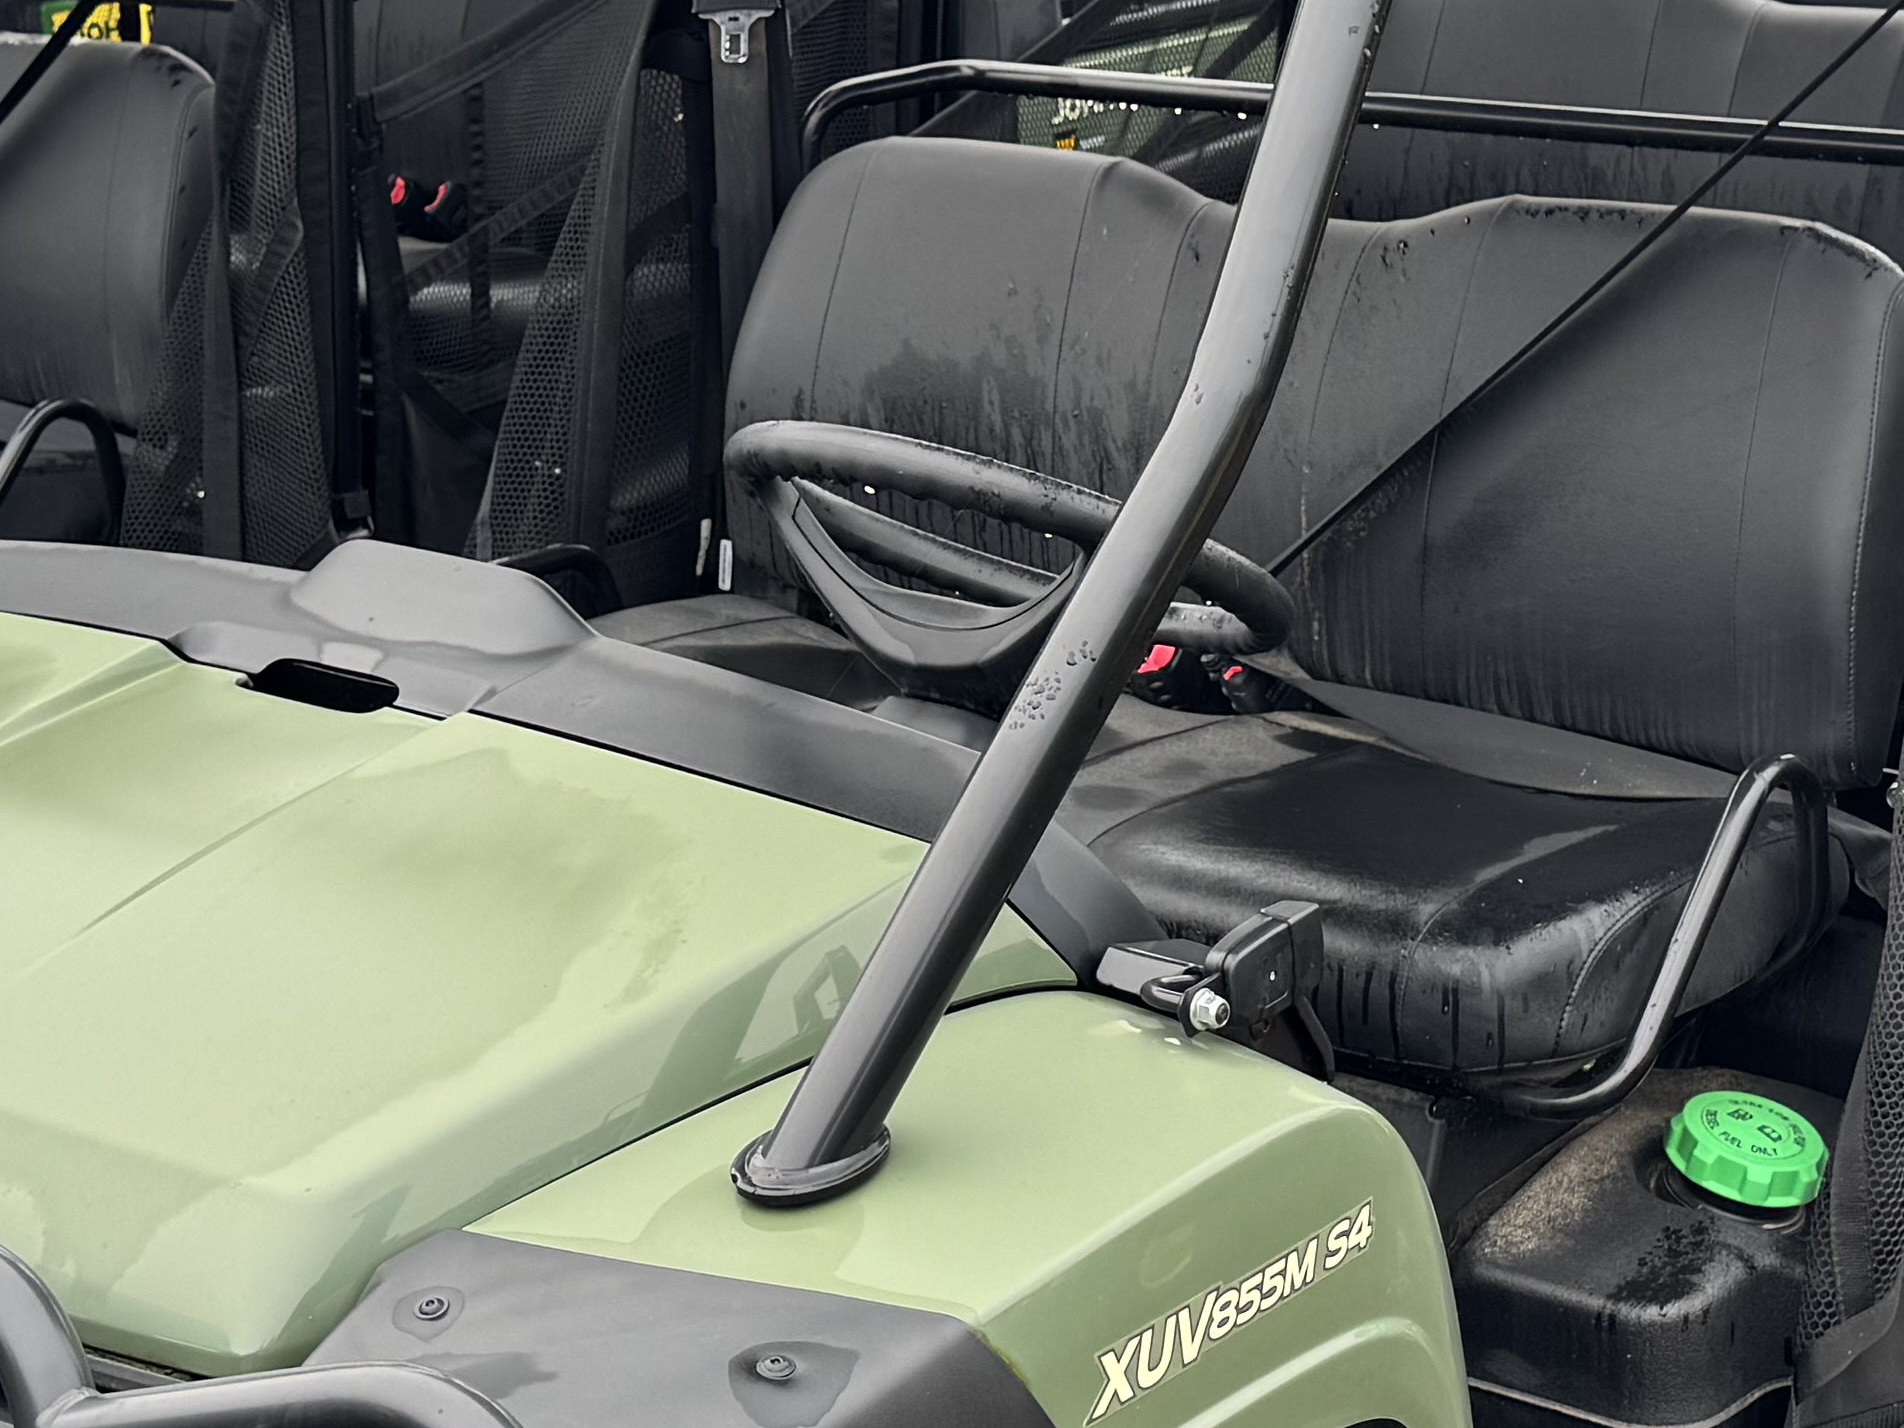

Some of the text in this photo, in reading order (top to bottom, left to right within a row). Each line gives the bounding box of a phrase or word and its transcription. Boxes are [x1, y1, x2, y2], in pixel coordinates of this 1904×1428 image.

[1718, 1130, 1743, 1149] FUEL
[1750, 1143, 1778, 1157] ONLY
[1086, 1201, 1374, 1424] XUV855M S4
